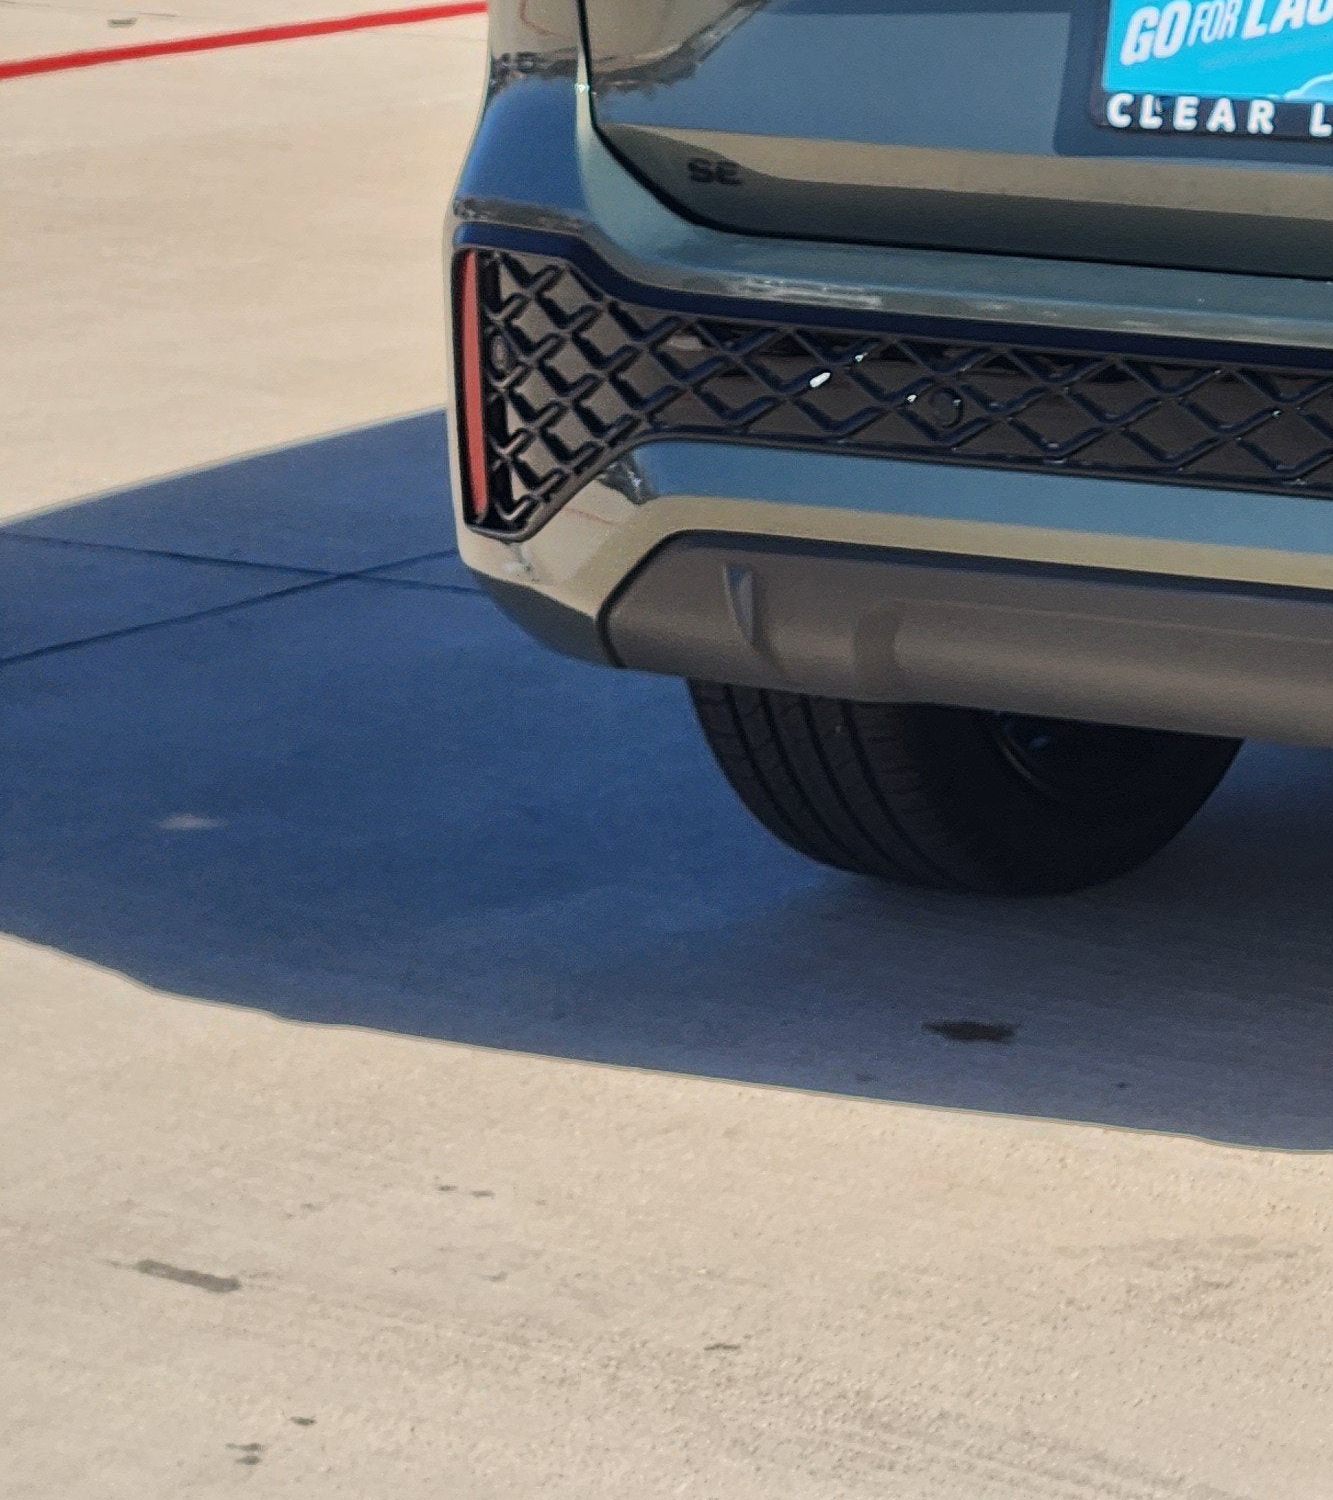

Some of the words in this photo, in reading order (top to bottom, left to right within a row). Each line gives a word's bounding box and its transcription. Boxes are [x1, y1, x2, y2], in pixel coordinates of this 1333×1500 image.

[1120, 0, 1192, 66] GO
[1106, 93, 1274, 134] CLEAR
[688, 157, 742, 185] SE
